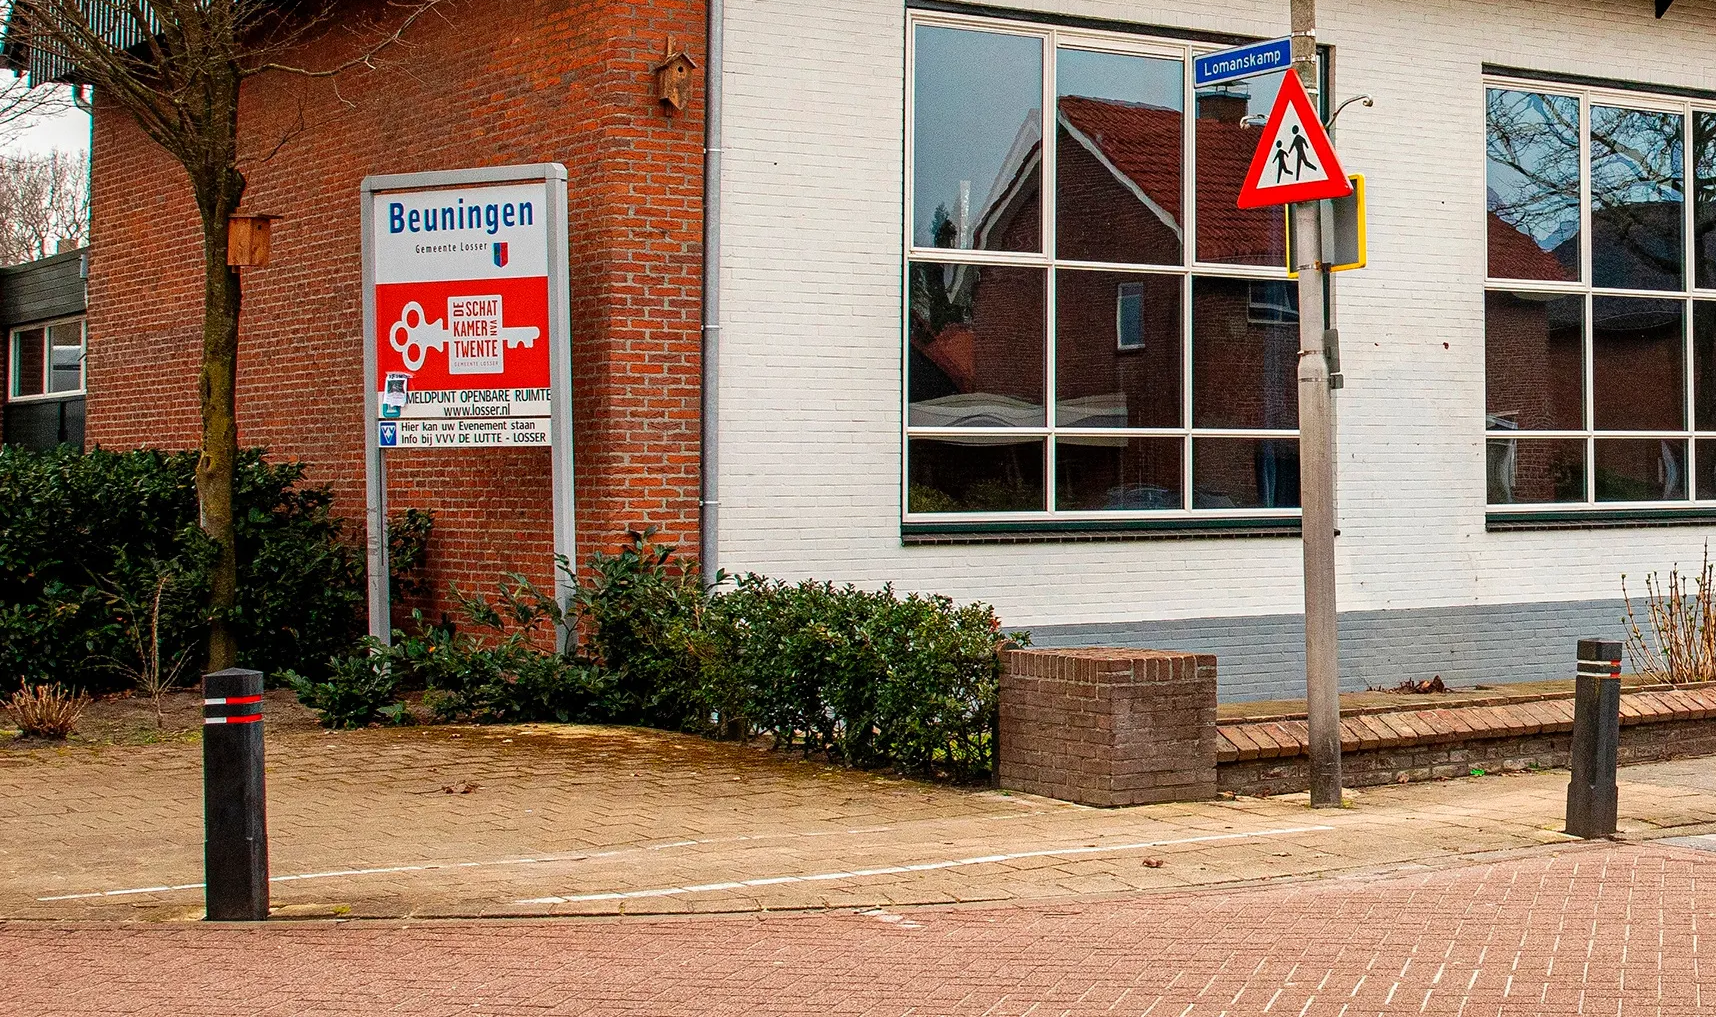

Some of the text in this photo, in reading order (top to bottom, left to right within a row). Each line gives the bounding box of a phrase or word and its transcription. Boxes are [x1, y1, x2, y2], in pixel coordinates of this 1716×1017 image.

[1204, 50, 1281, 76] Lomanskamp
[389, 198, 533, 235] Beuningen
[415, 242, 488, 254] Gemeente Losser
[453, 300, 498, 317] DE SCHAT
[453, 319, 498, 337] KAMER VAN
[454, 340, 498, 358] TWENTE
[406, 391, 456, 404] MELDPUNT
[460, 390, 510, 403] OPENBARE
[515, 388, 551, 402] RUIMTE
[444, 403, 510, 416] www.losser.nl
[401, 421, 535, 431] Hier kan uw Evenement staan
[401, 434, 418, 444] Info
[421, 434, 433, 446] bij
[436, 434, 455, 444] VVV
[459, 433, 470, 443] DE
[474, 433, 502, 443] LUTTE
[513, 432, 546, 443] LOSSER
